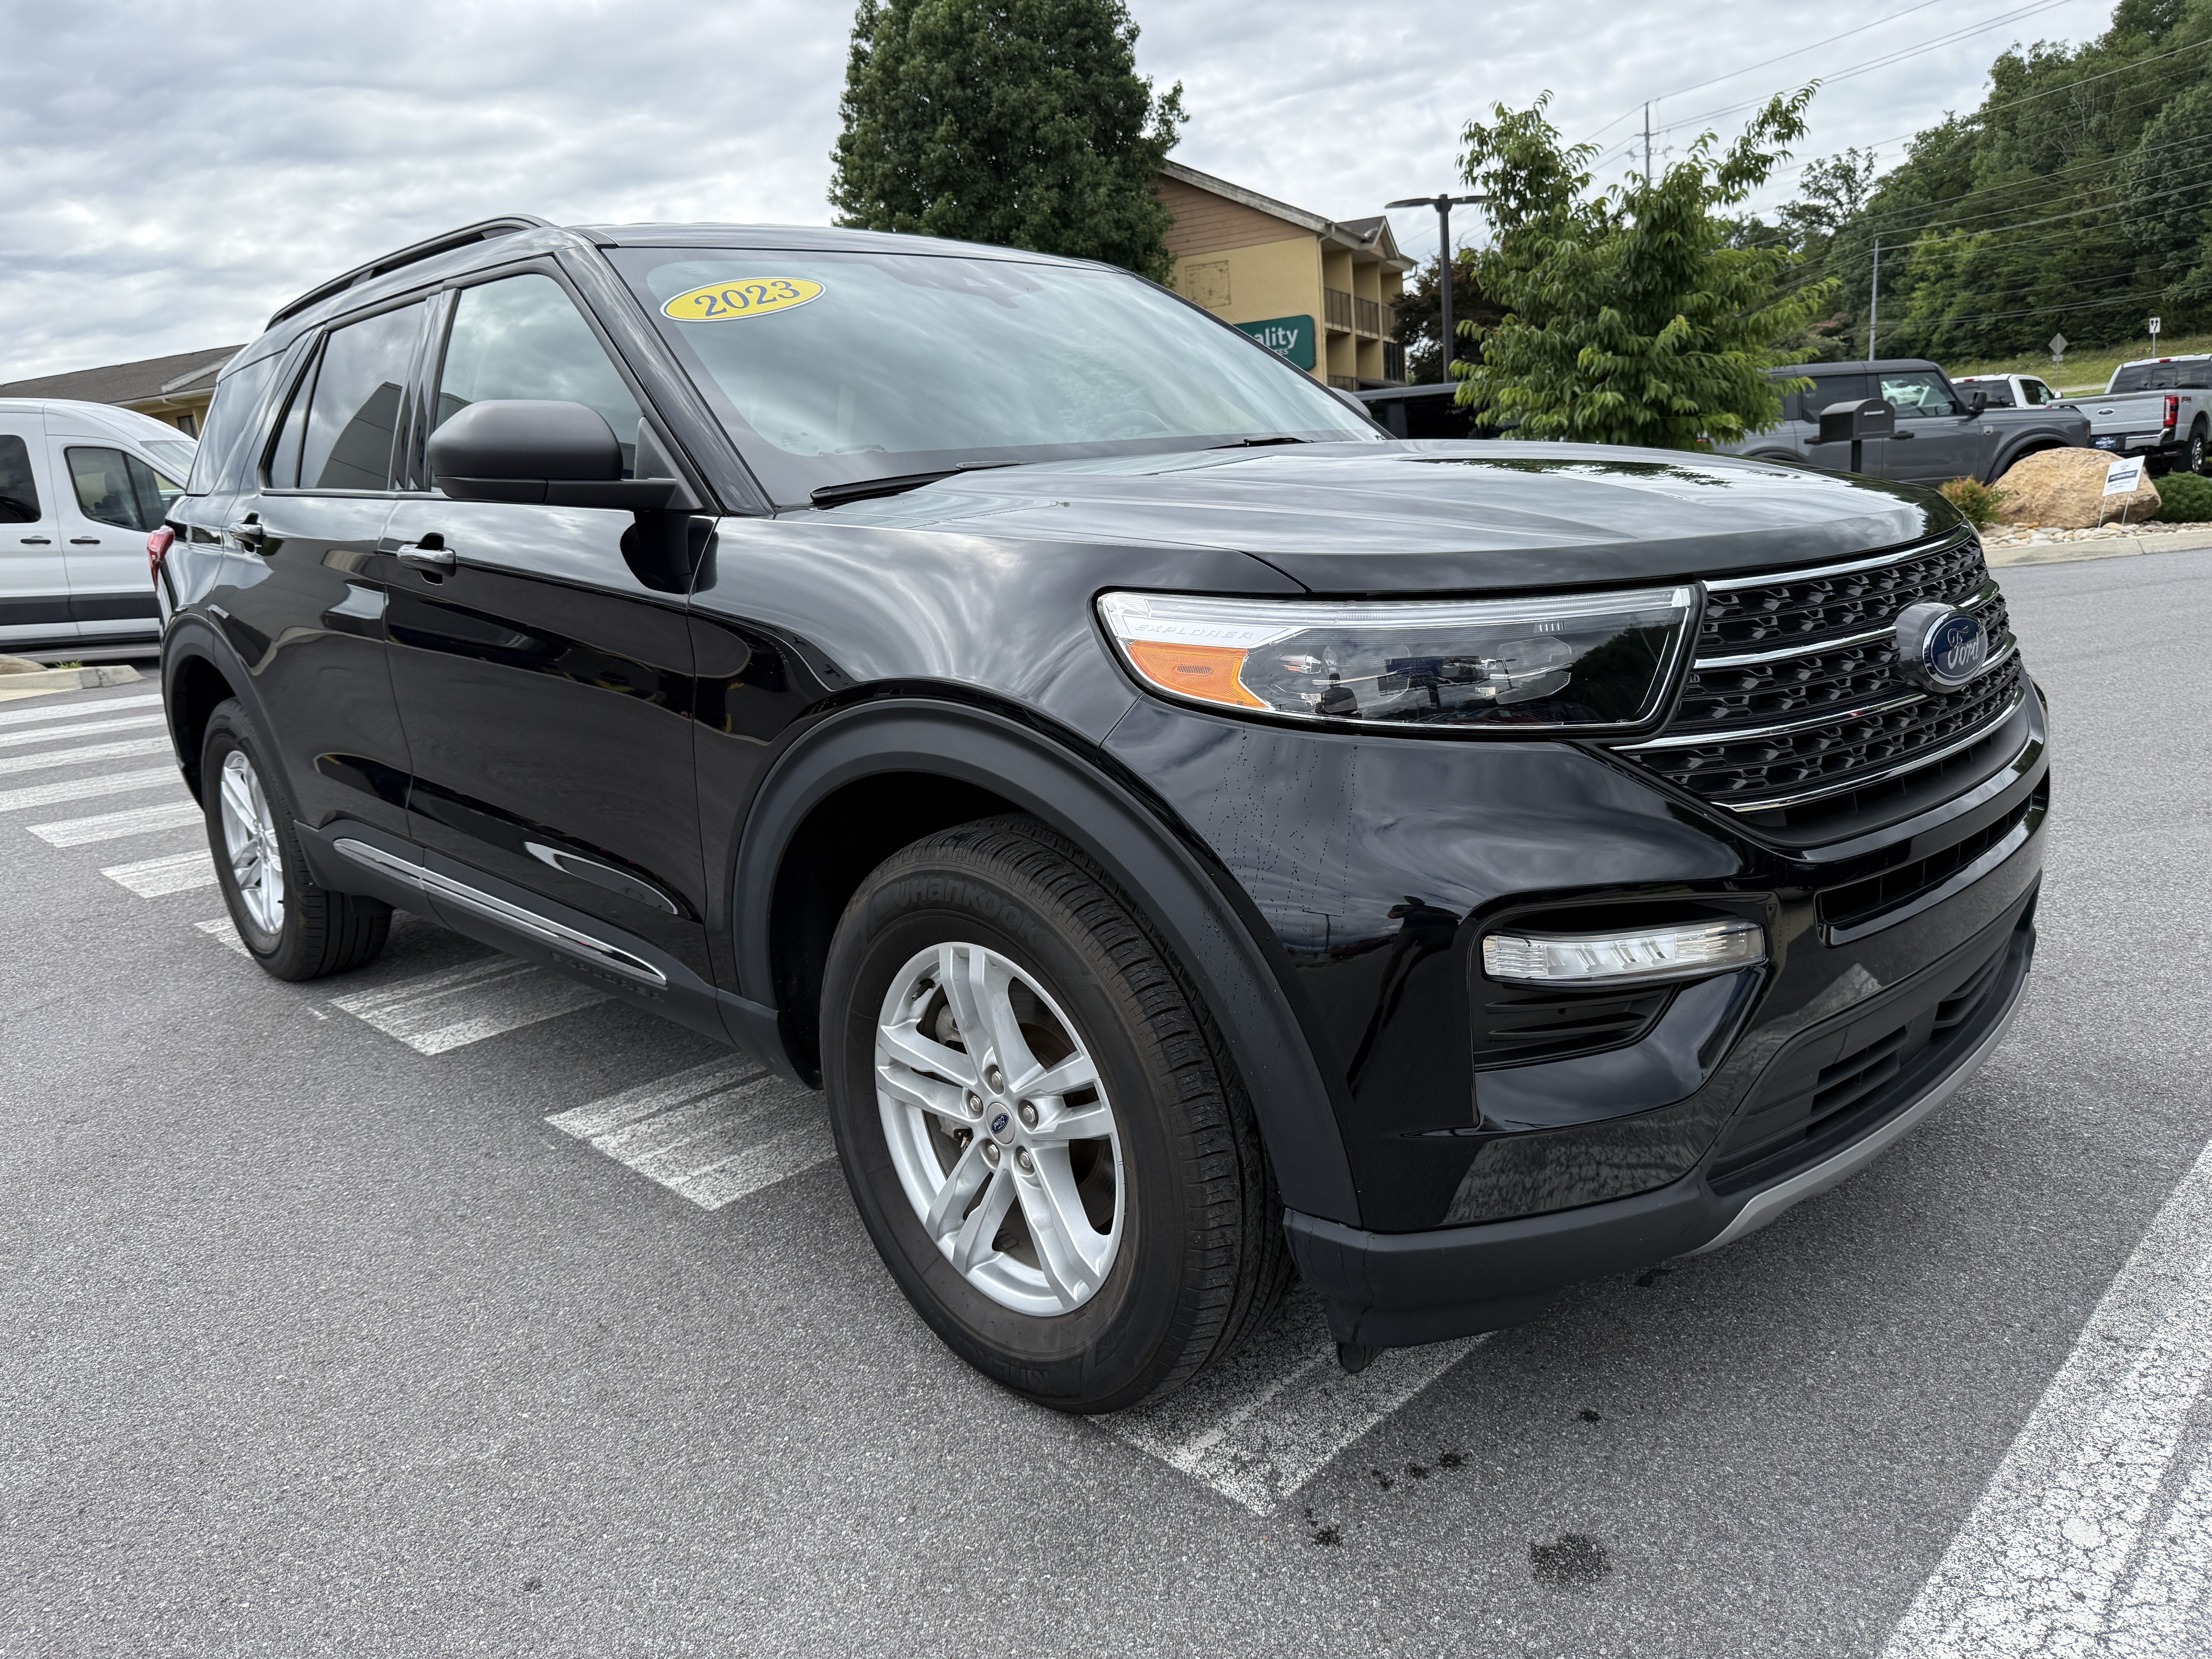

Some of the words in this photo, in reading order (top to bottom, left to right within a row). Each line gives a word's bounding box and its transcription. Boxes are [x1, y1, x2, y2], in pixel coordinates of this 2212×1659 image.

[694, 281, 800, 317] 2023
[1135, 624, 1254, 639] EXPLORER
[1948, 625, 1979, 670] Ford
[993, 1114, 1005, 1130] Ford
